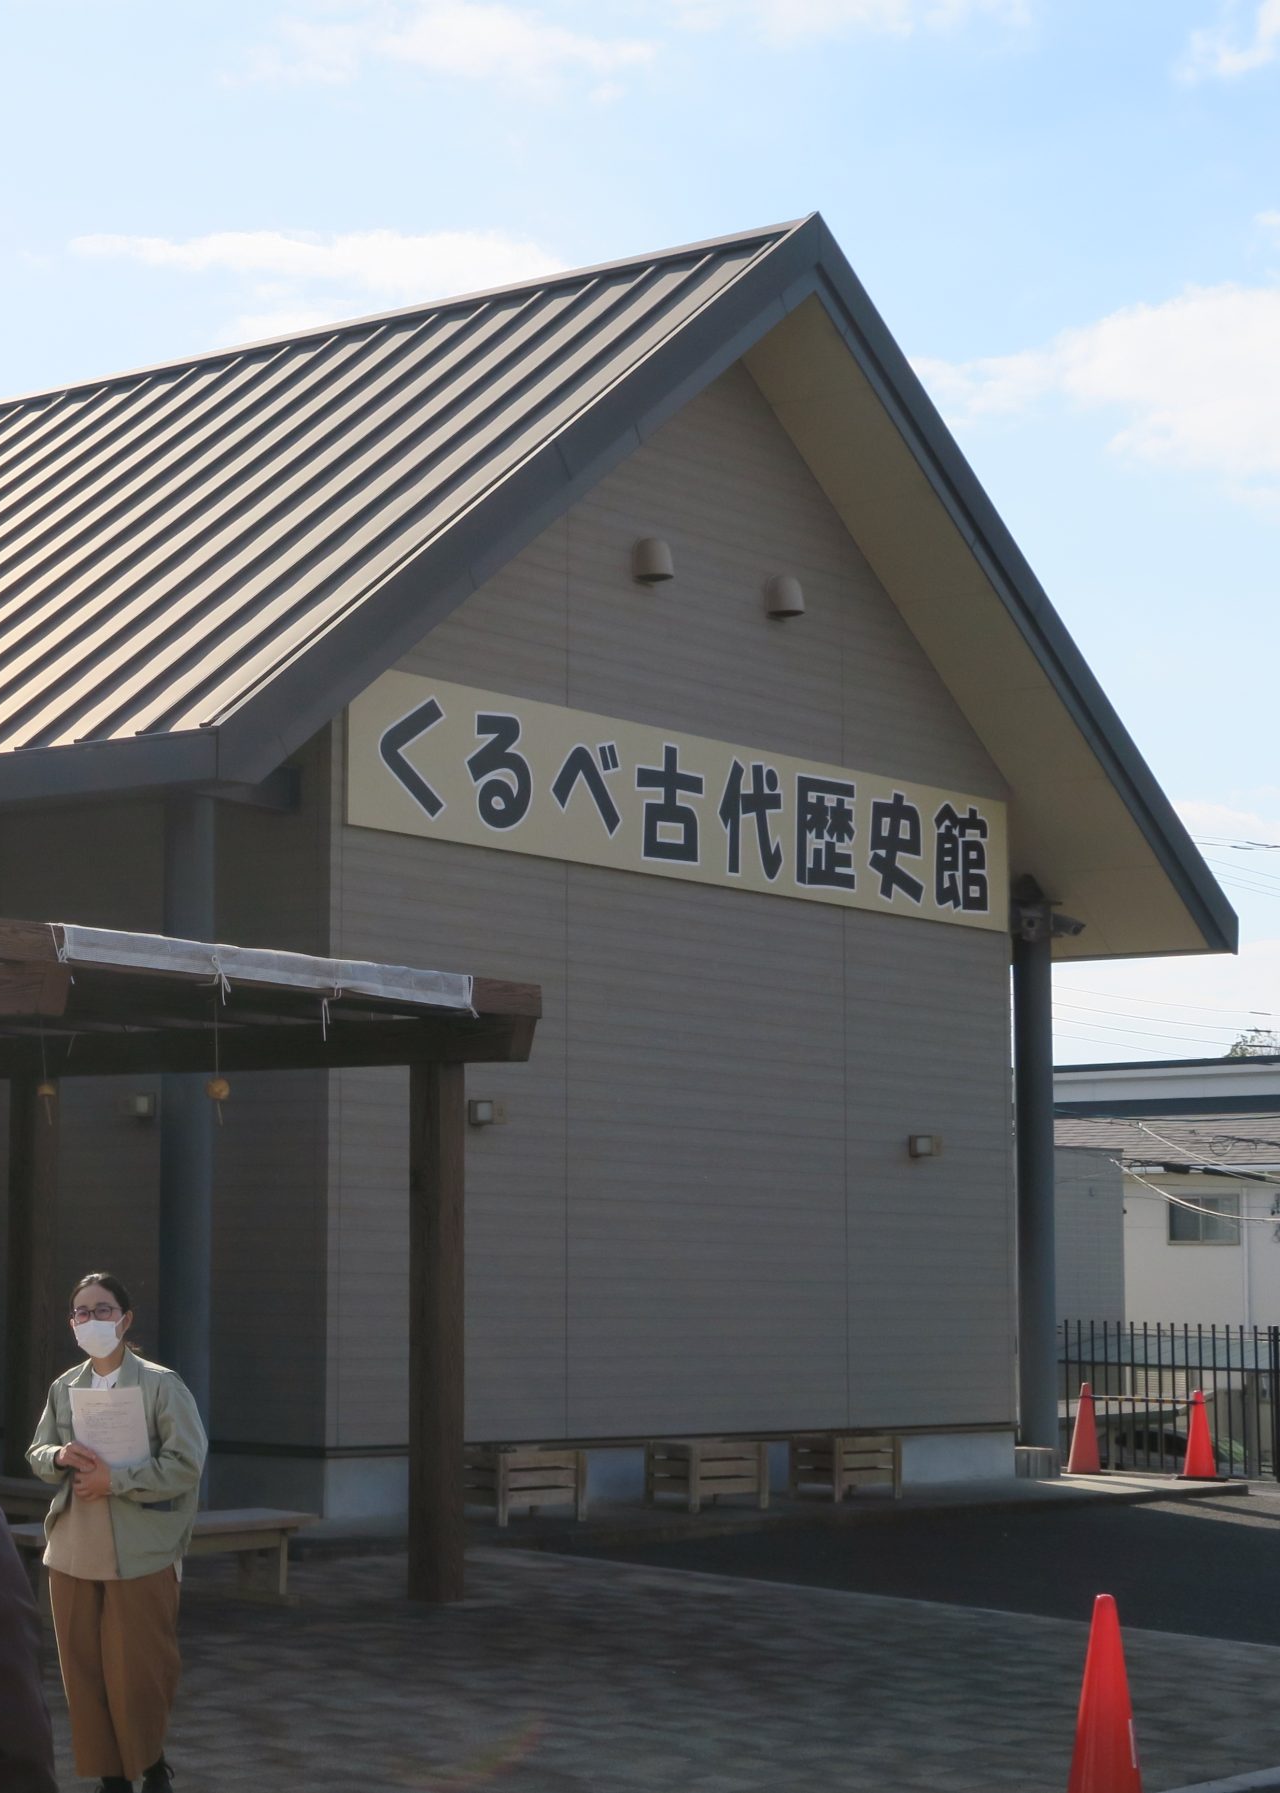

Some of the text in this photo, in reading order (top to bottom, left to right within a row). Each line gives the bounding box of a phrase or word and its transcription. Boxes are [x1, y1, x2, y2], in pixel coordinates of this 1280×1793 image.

[378, 696, 989, 914] くるべ古代歴史館
